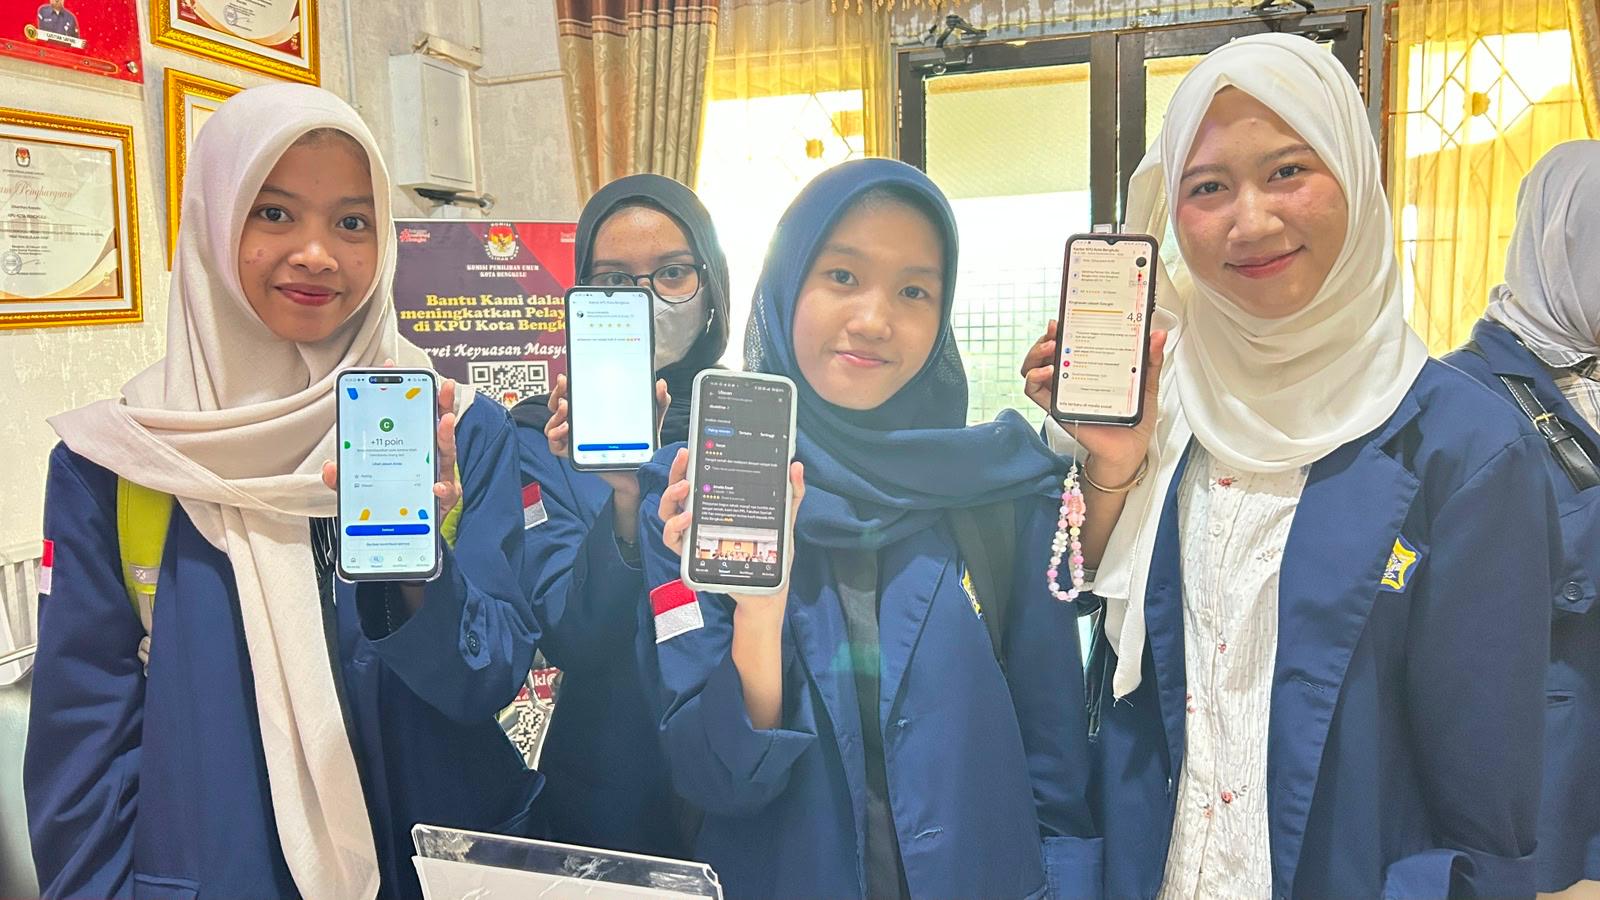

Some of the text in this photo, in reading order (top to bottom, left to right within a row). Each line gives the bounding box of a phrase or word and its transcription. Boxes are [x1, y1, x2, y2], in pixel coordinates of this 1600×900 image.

[426, 294, 477, 306] Bantu
[481, 294, 524, 306] Kami
[400, 307, 522, 321] meningkatkan
[1126, 312, 1143, 324] 4,8
[413, 321, 431, 332] di
[434, 320, 471, 331] KPU
[475, 319, 515, 331] Kota
[454, 343, 521, 360] Kepuasan
[384, 436, 404, 447] poin
